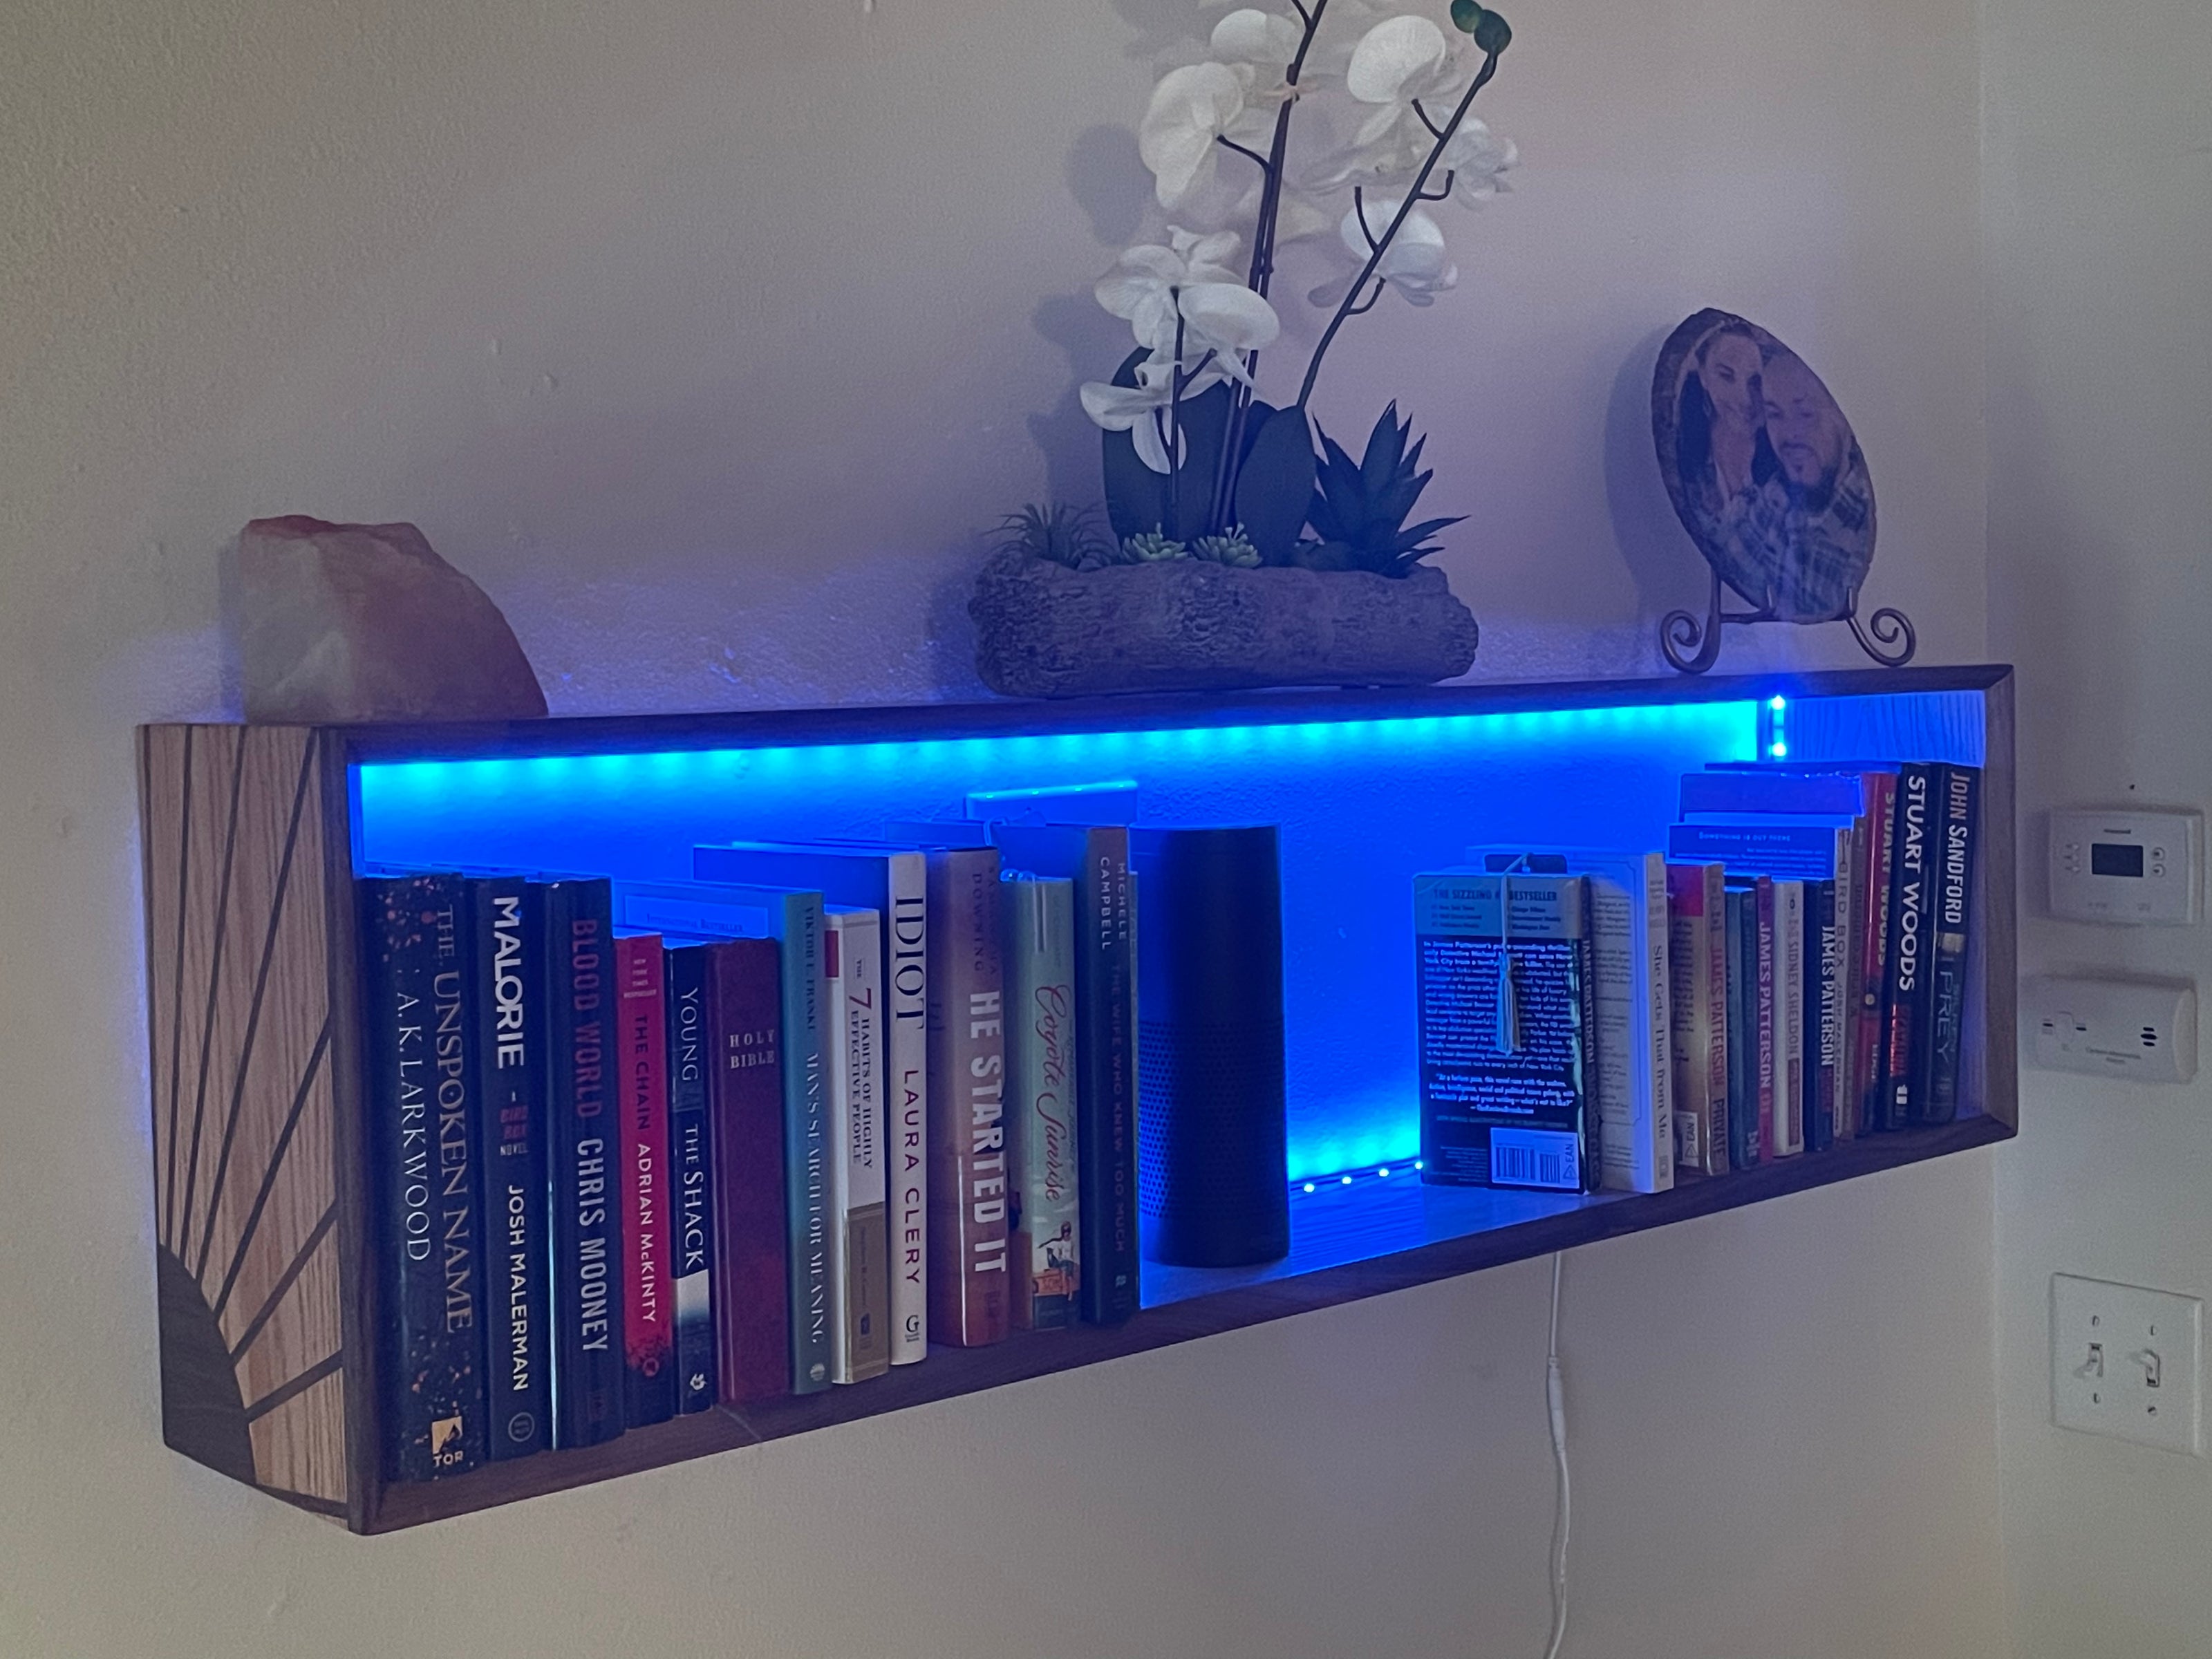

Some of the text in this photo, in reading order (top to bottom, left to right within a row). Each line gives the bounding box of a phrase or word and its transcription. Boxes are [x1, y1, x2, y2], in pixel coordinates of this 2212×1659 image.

[1904, 776, 1926, 874] STUART
[1944, 771, 1970, 924] JOHN SANDFORD
[438, 903, 455, 957] THE
[972, 873, 984, 971] DOWNING
[1100, 856, 1112, 950] CAMPBELL
[1117, 863, 1127, 941] MICHELE
[1821, 926, 1835, 976] JAMES
[1837, 861, 1848, 967] BIRD BOX
[1899, 881, 1920, 991] WOODS
[493, 897, 525, 1069] MALORIE
[849, 987, 872, 1010] 7
[895, 897, 924, 1030] IDIOT
[1759, 922, 1772, 983] JAMES
[572, 919, 601, 1118] BLOOD WORLD
[680, 987, 698, 1081] YOUNG
[730, 1029, 775, 1048] HOLY
[730, 1050, 775, 1069] BIBLE
[1711, 1001, 1725, 1086] PATTERSON
[1759, 986, 1772, 1088] PATTERSON
[1821, 982, 1834, 1067] PATTERSON
[1937, 970, 1953, 1063] PREY
[635, 1015, 651, 1130] THE CHAIN
[852, 1011, 861, 1163] EFFECTIVE PEOPLE
[861, 1018, 872, 1169] HABITS OF HIGHLY
[1035, 984, 1070, 1202] Coyote Sunrise
[1113, 1053, 1123, 1096] WHO
[400, 1060, 431, 1261] LARKWOOD
[434, 971, 473, 1333] UNSPOKEN NAME
[500, 1143, 528, 1156] NOVEL
[970, 991, 1006, 1272] HE STARTED IT
[1114, 1101, 1123, 1152] KNEW
[683, 1123, 704, 1269] THE SHACK
[904, 1070, 920, 1284] LAURA CLERY
[577, 1138, 608, 1351] CHRIS MOONEY
[637, 1143, 656, 1322] ADRIAN McKINTY
[508, 1184, 529, 1391] JOSH MALERMAN
[906, 1314, 919, 1333] G
[433, 1450, 464, 1468] TOR
